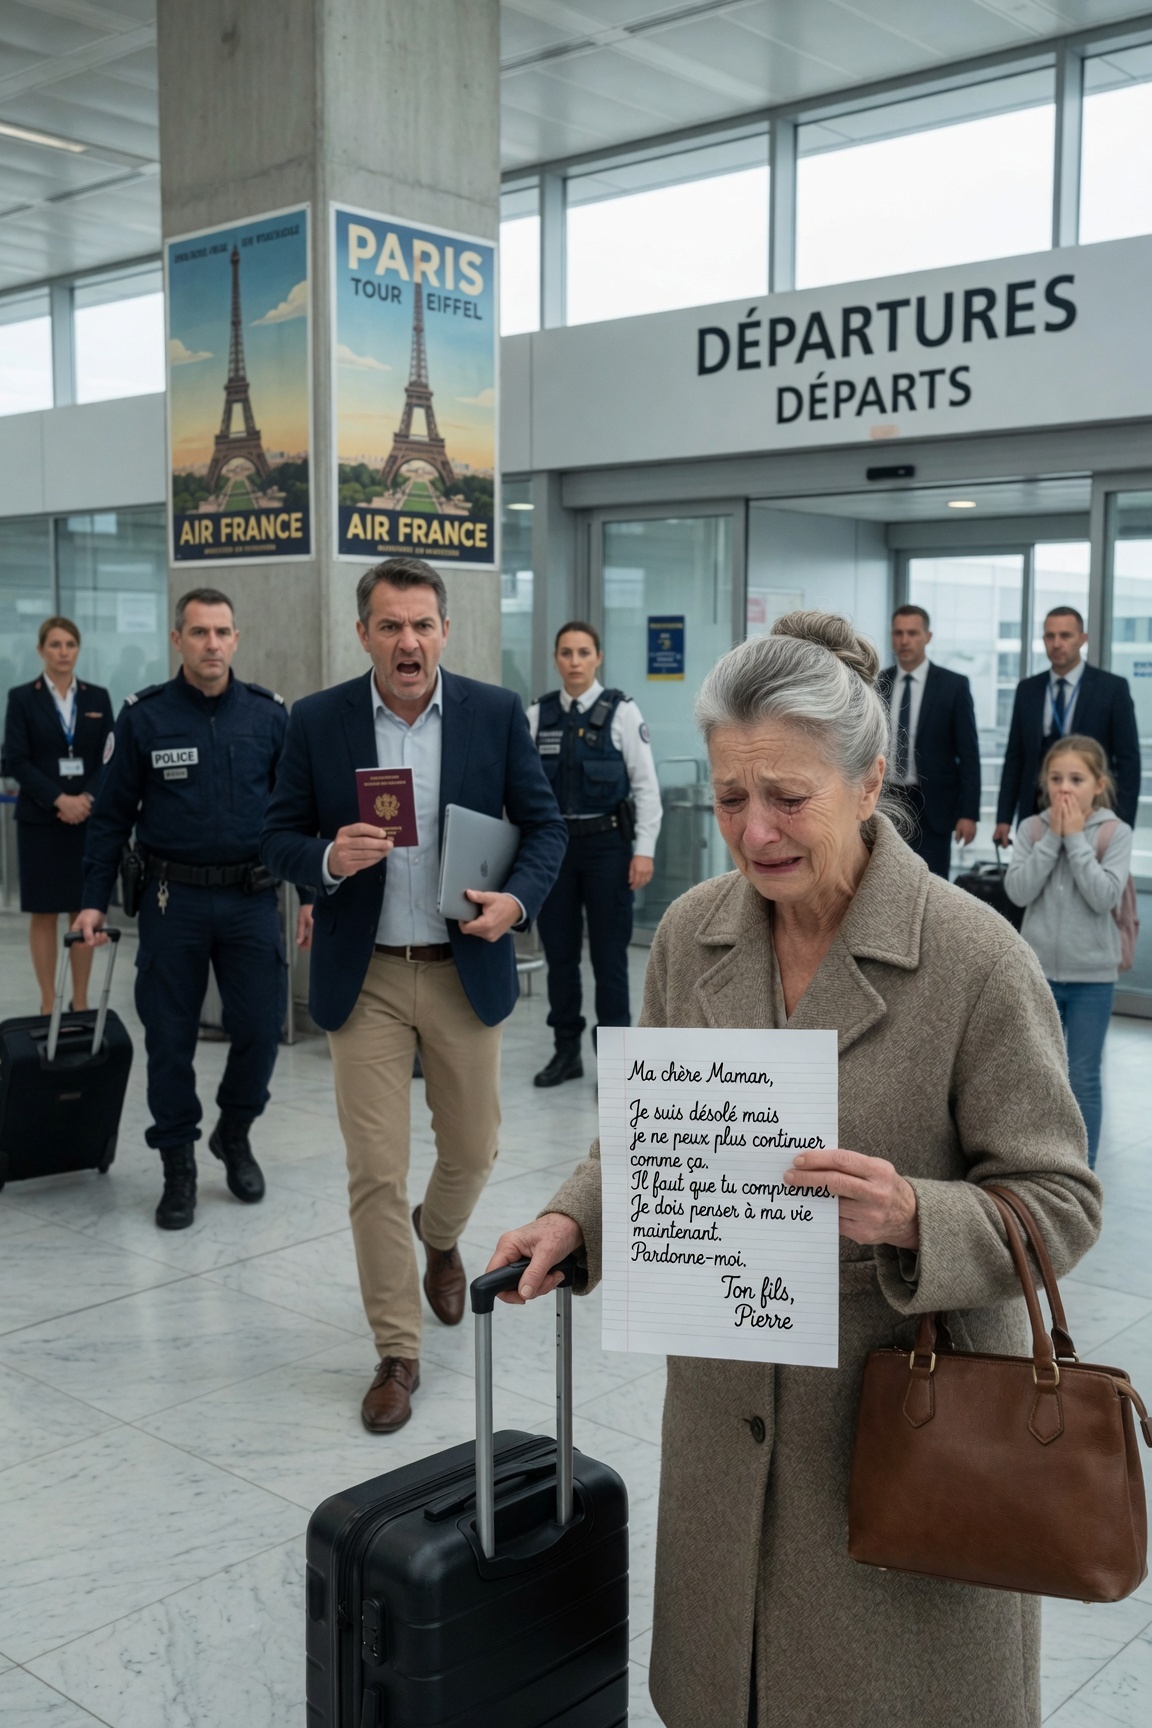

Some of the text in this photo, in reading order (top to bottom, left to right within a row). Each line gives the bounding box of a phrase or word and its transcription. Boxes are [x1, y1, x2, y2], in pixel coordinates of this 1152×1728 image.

[348, 223, 484, 296] PARIS
[351, 277, 483, 320] TOUR EIFFEL
[697, 274, 1077, 376] DÉPARTURES
[776, 365, 972, 424] DÉPARTS
[179, 512, 303, 546] AIR FRANCE
[346, 513, 488, 548] AIR FRANCE
[155, 751, 195, 765] POLICE
[627, 1059, 774, 1087] Ma chère Maman,
[629, 1099, 780, 1127] Je suis désolé mais
[629, 1125, 826, 1153] je ne peux plus continuer
[630, 1154, 709, 1173] comme ça.
[630, 1169, 835, 1202] Il faut que tu comprennes.
[630, 1193, 814, 1223] Je dois penser à ma vie
[632, 1220, 722, 1242] maintenant.
[630, 1241, 747, 1267] Pardonne-moi.
[721, 1275, 795, 1309] Ton fils,
[734, 1303, 794, 1330] Pierre
